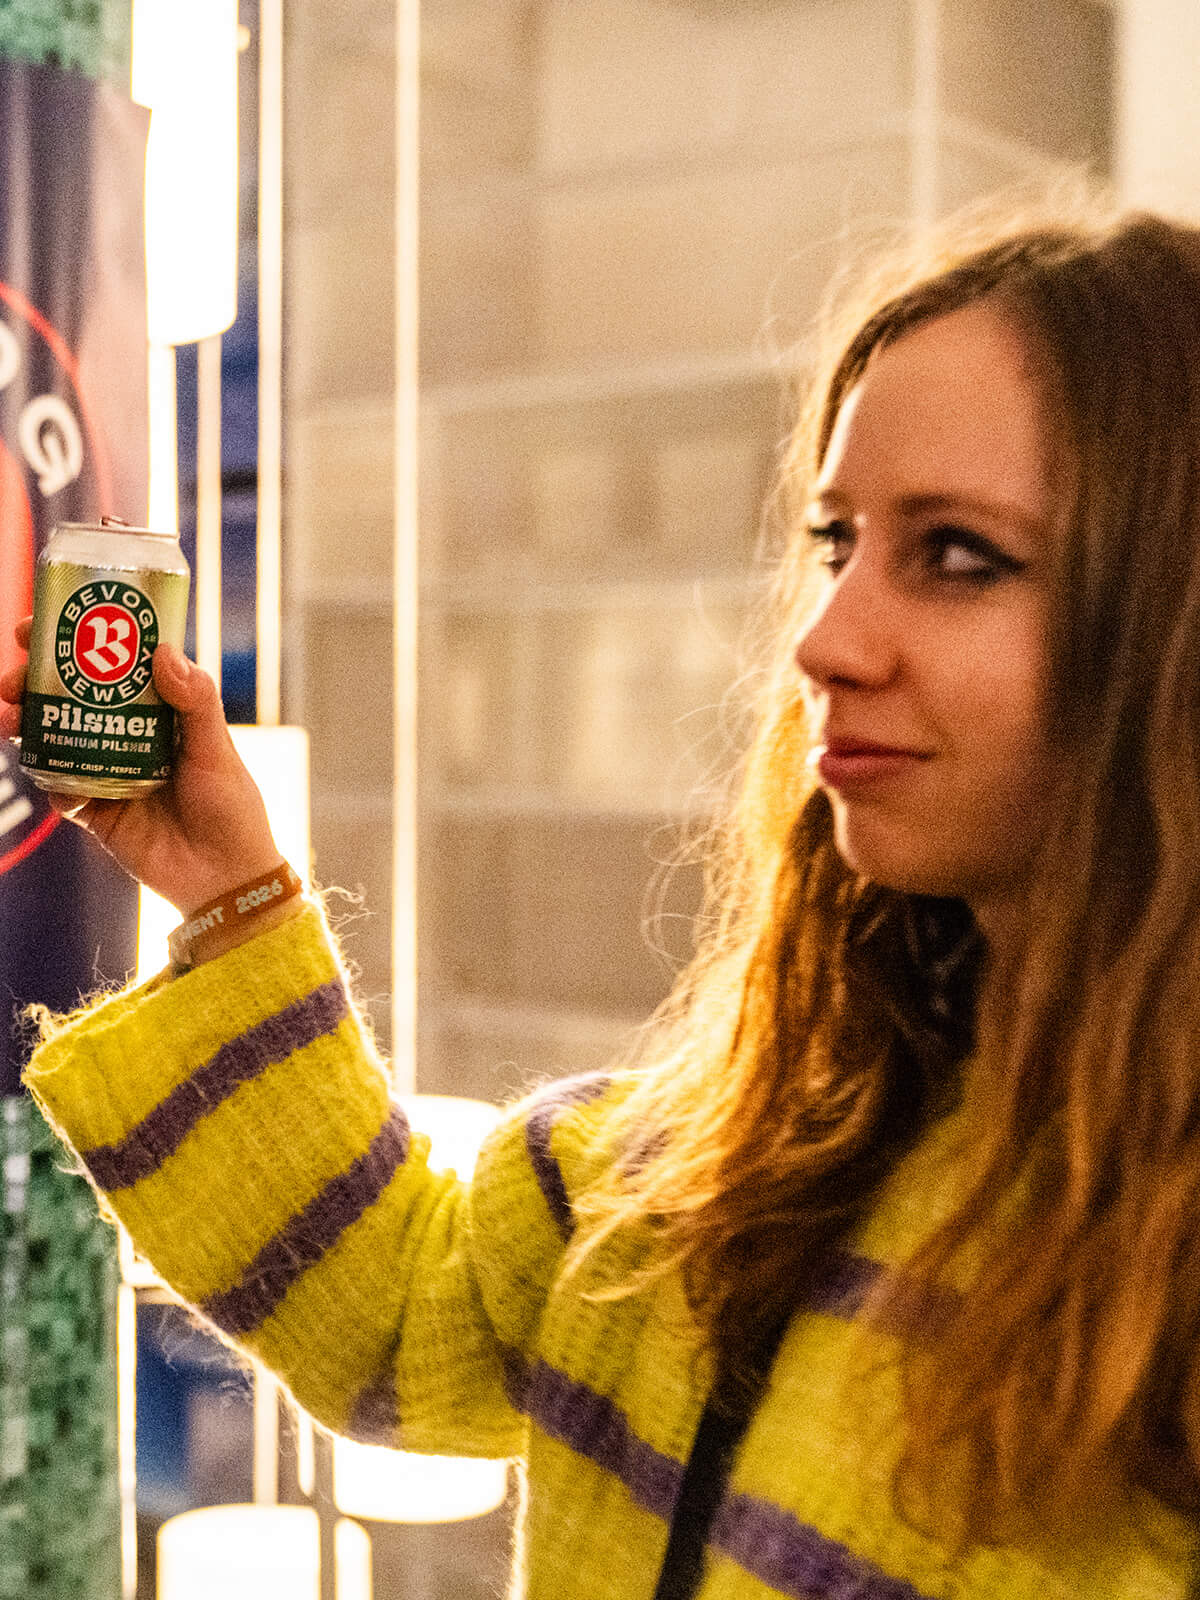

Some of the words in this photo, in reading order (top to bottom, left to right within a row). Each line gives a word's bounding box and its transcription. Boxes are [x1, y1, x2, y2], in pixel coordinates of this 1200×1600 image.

[64, 584, 154, 630] BEVOG
[58, 641, 153, 702] BREWERY
[41, 703, 158, 737] Pilsner
[43, 733, 99, 750] PREMIUM
[101, 739, 152, 753] PILSNER
[48, 759, 74, 769] BRIGHT
[80, 763, 105, 772] CRISP
[110, 766, 142, 775] PERFECT
